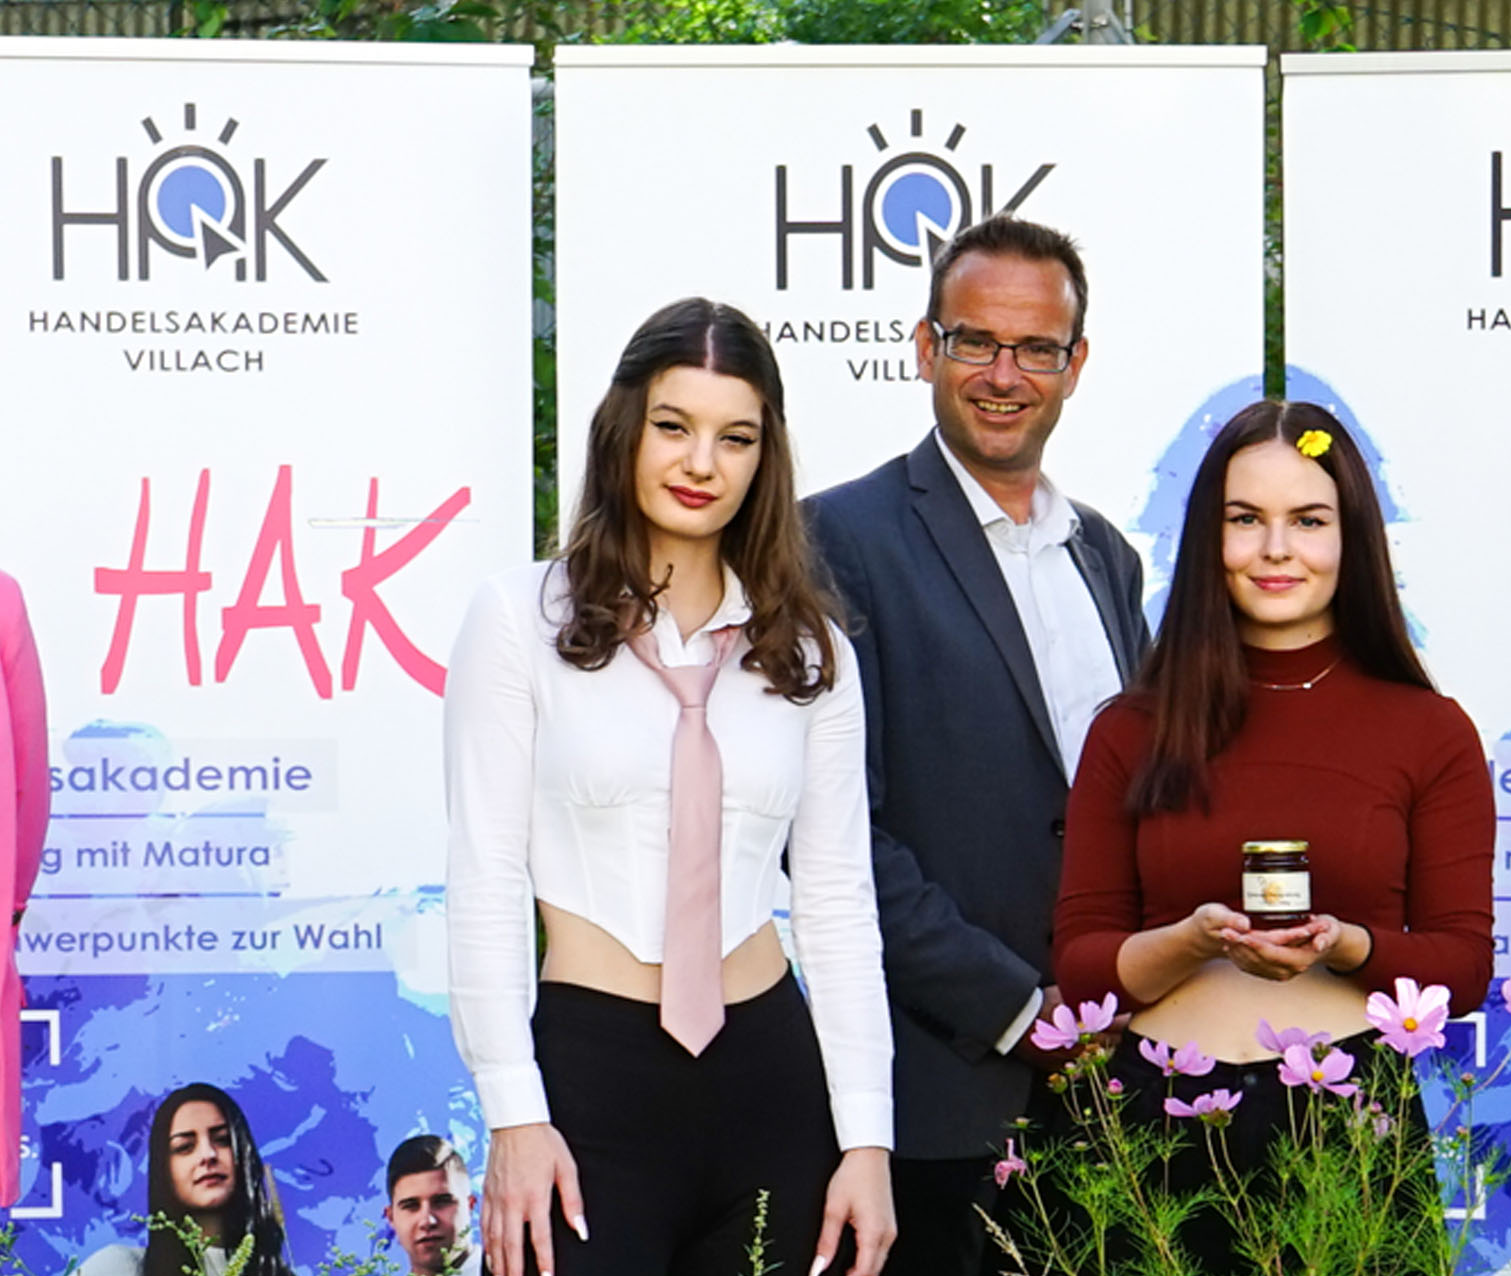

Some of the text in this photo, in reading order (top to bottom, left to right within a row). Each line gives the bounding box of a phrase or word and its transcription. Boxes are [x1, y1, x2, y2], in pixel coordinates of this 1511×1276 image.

[28, 311, 359, 335] HANDELSAKADEMIE
[757, 320, 917, 343] ANDELS
[123, 350, 265, 373] VILLACH
[847, 359, 921, 382] VILL
[94, 464, 471, 700] HAK
[76, 842, 131, 868] mit
[143, 841, 270, 868] Matura
[15, 924, 383, 958] werpunkte zur Wahl
